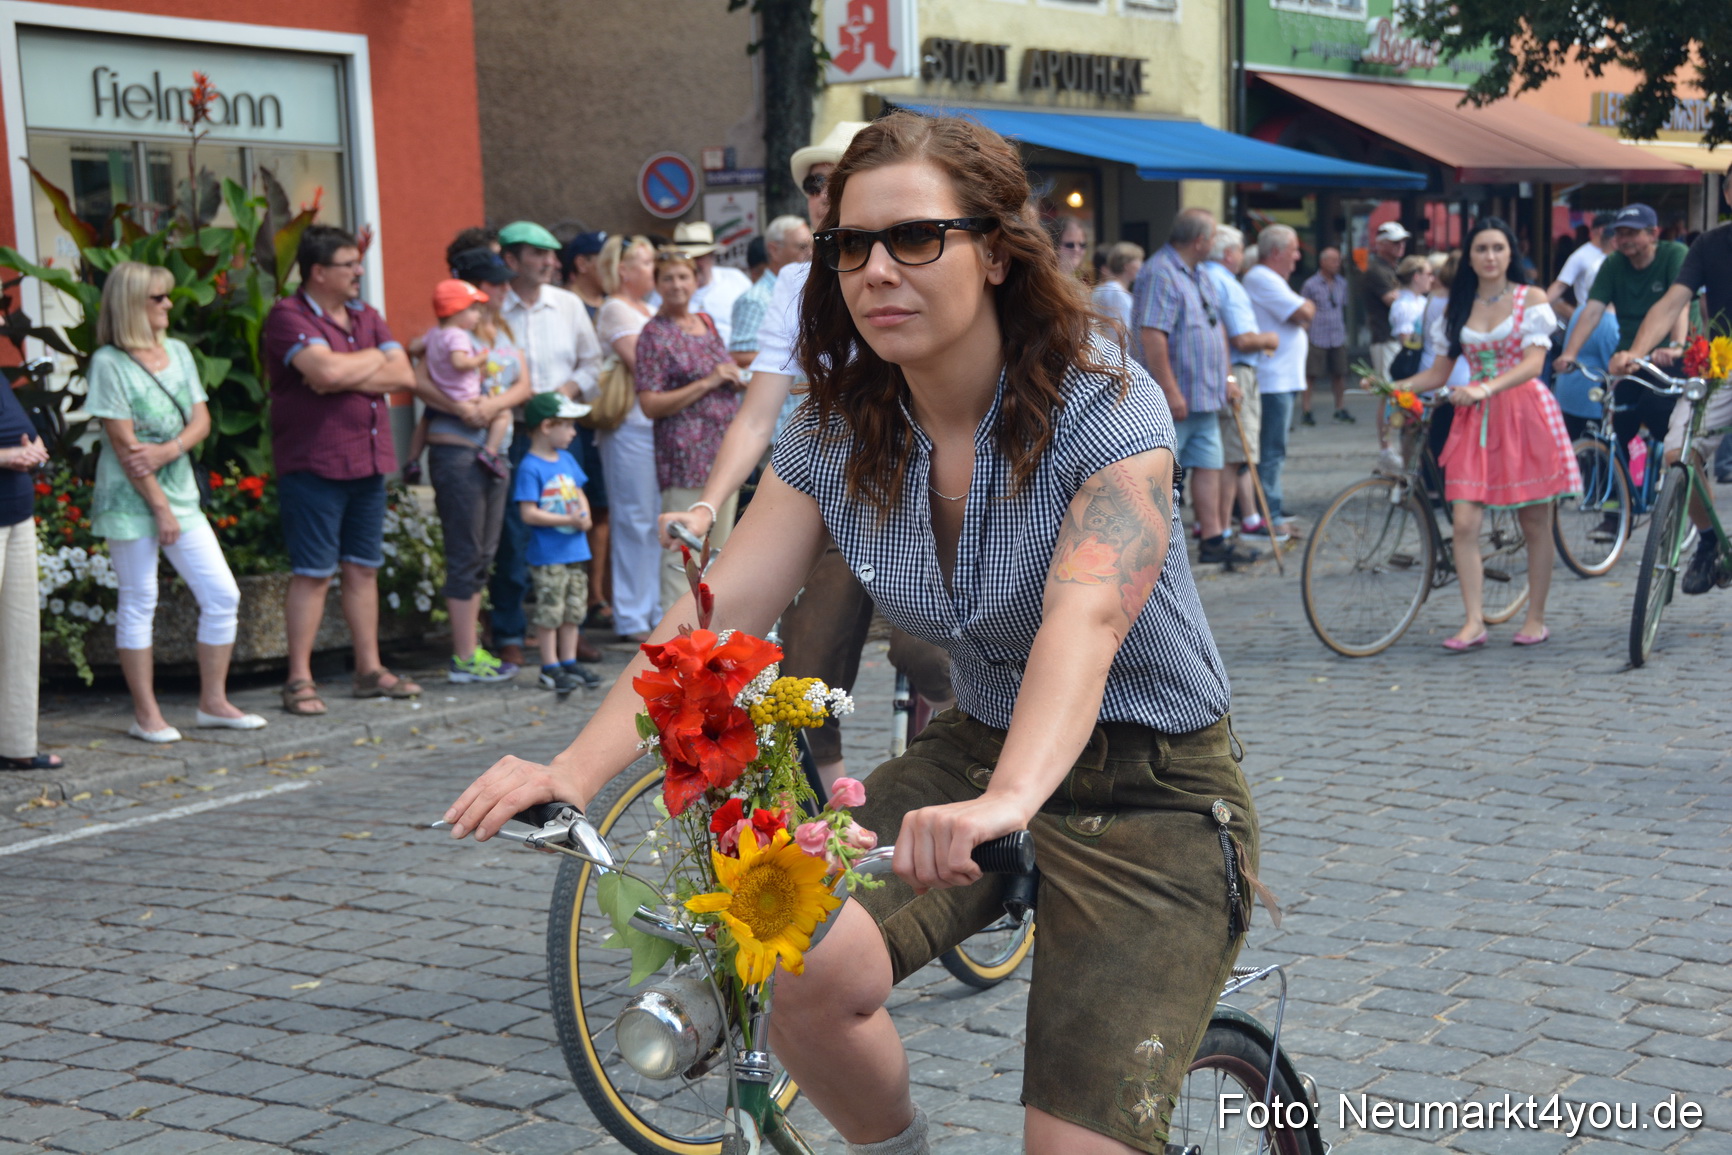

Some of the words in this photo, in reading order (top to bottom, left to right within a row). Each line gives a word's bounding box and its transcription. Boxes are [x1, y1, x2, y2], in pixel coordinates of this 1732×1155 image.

[92, 65, 283, 128] fielmann
[921, 37, 1010, 84] STADT
[1019, 48, 1150, 96] APOTHEKE
